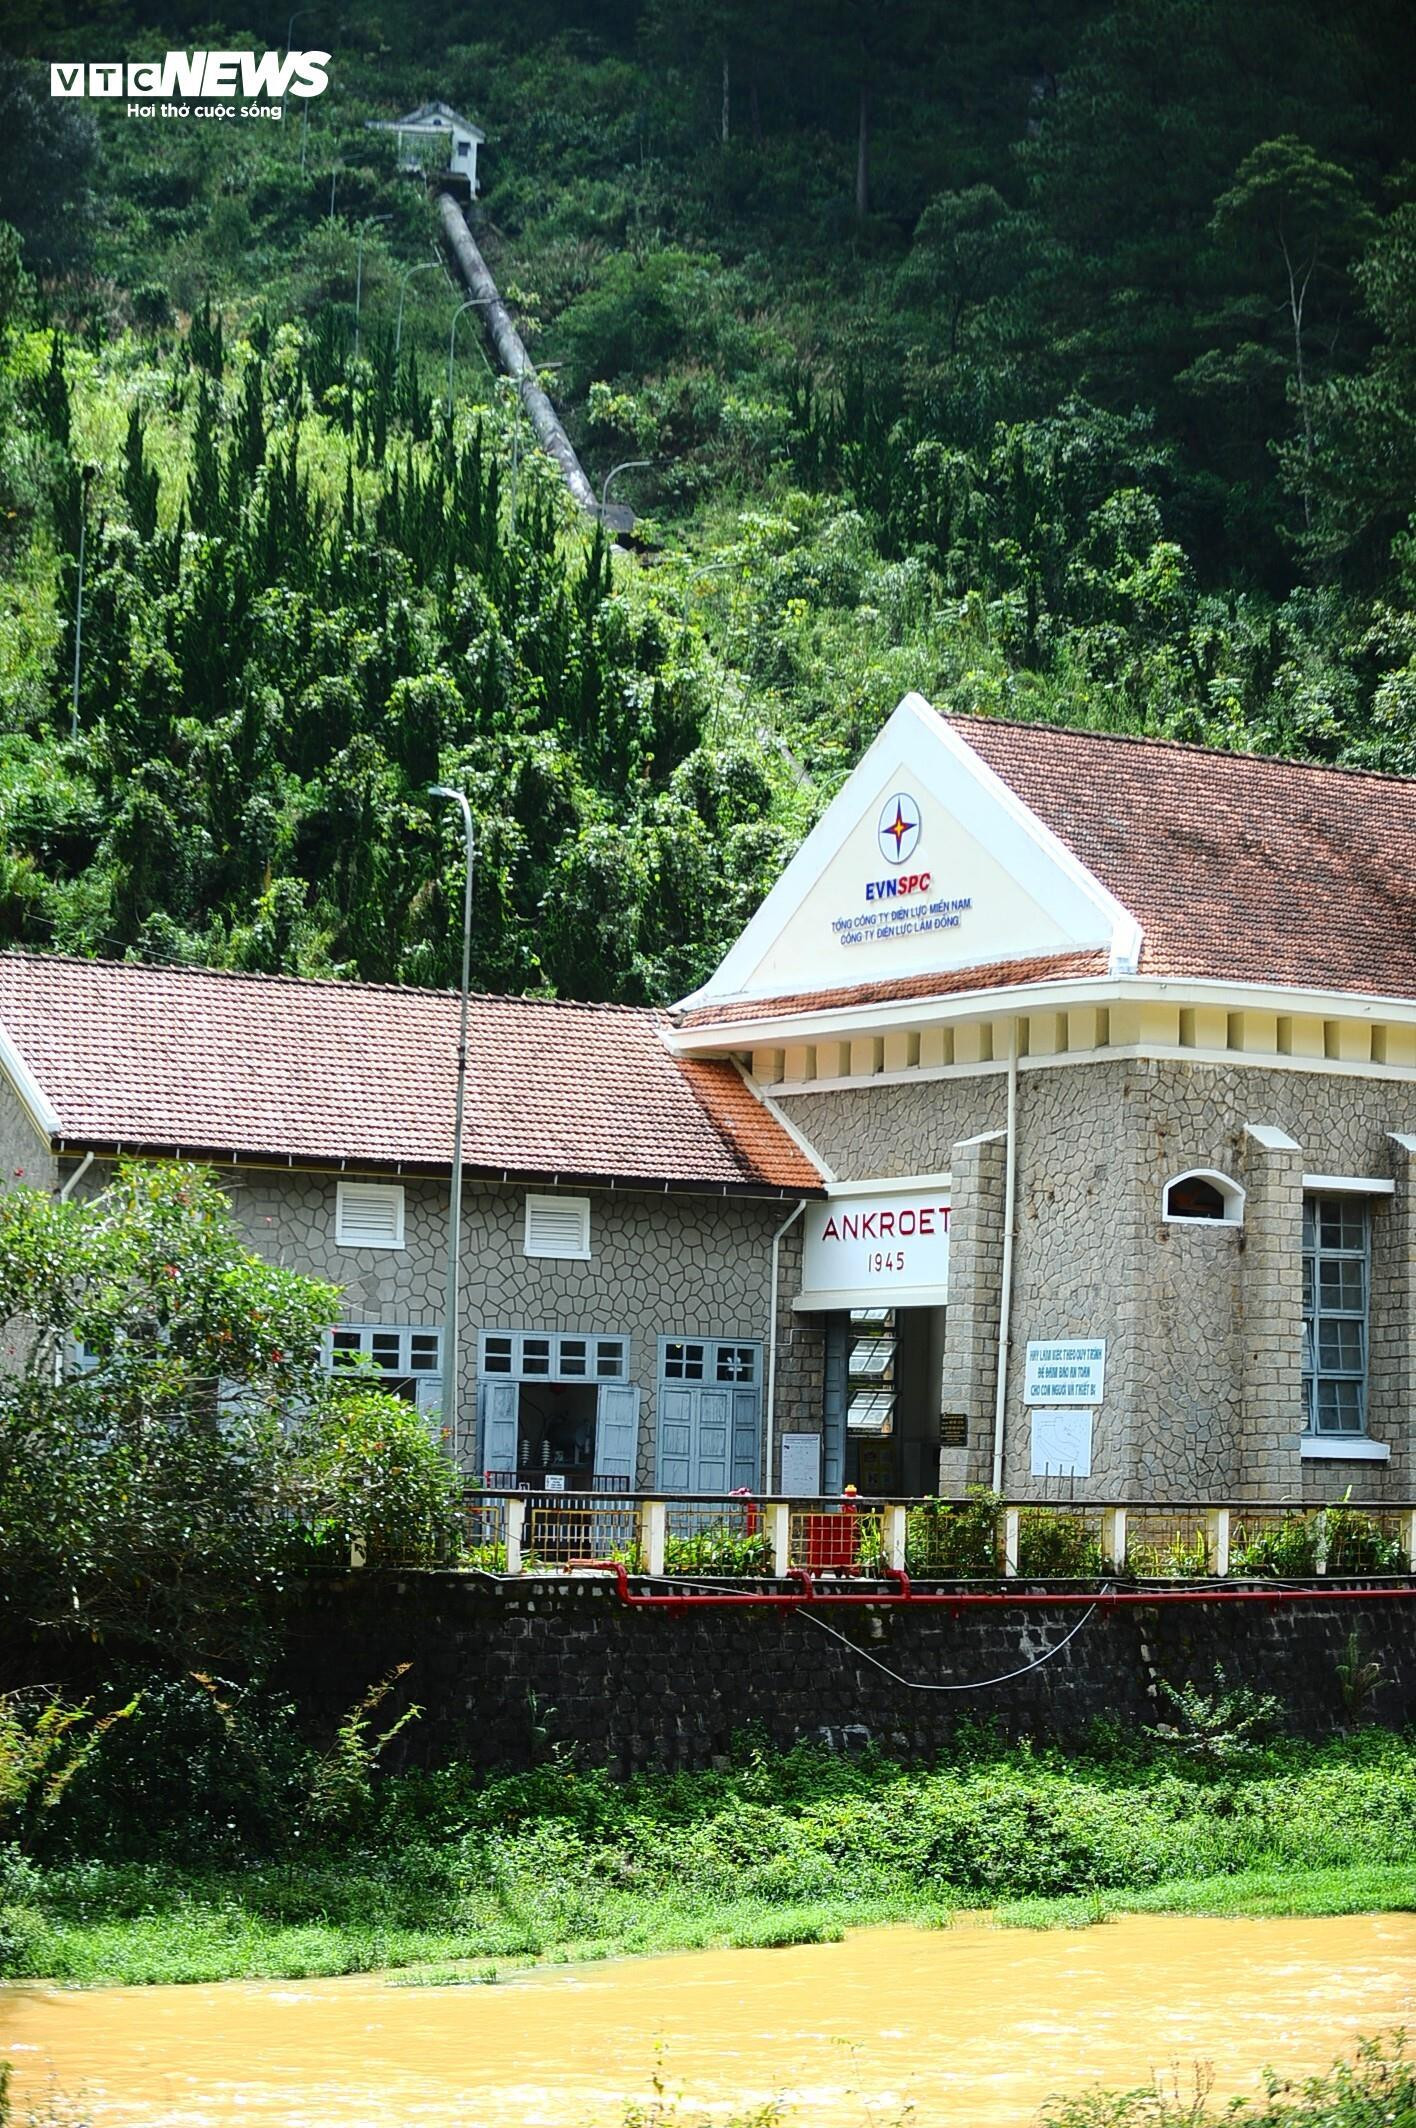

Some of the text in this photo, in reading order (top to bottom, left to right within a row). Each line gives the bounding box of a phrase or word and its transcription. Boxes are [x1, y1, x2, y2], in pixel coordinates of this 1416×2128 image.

[865, 872, 931, 901] EVNSPC
[854, 912, 876, 928] CÔNG
[879, 911, 889, 923] TY
[891, 907, 909, 921] ĐIỆN
[911, 905, 928, 919] LỰC
[951, 898, 971, 911] NAM
[841, 914, 959, 945] CÔNG TY ĐIỆN LỰC LÂM ĐỒNG
[822, 1207, 951, 1241] ANKROET
[869, 1252, 904, 1272] 1945
